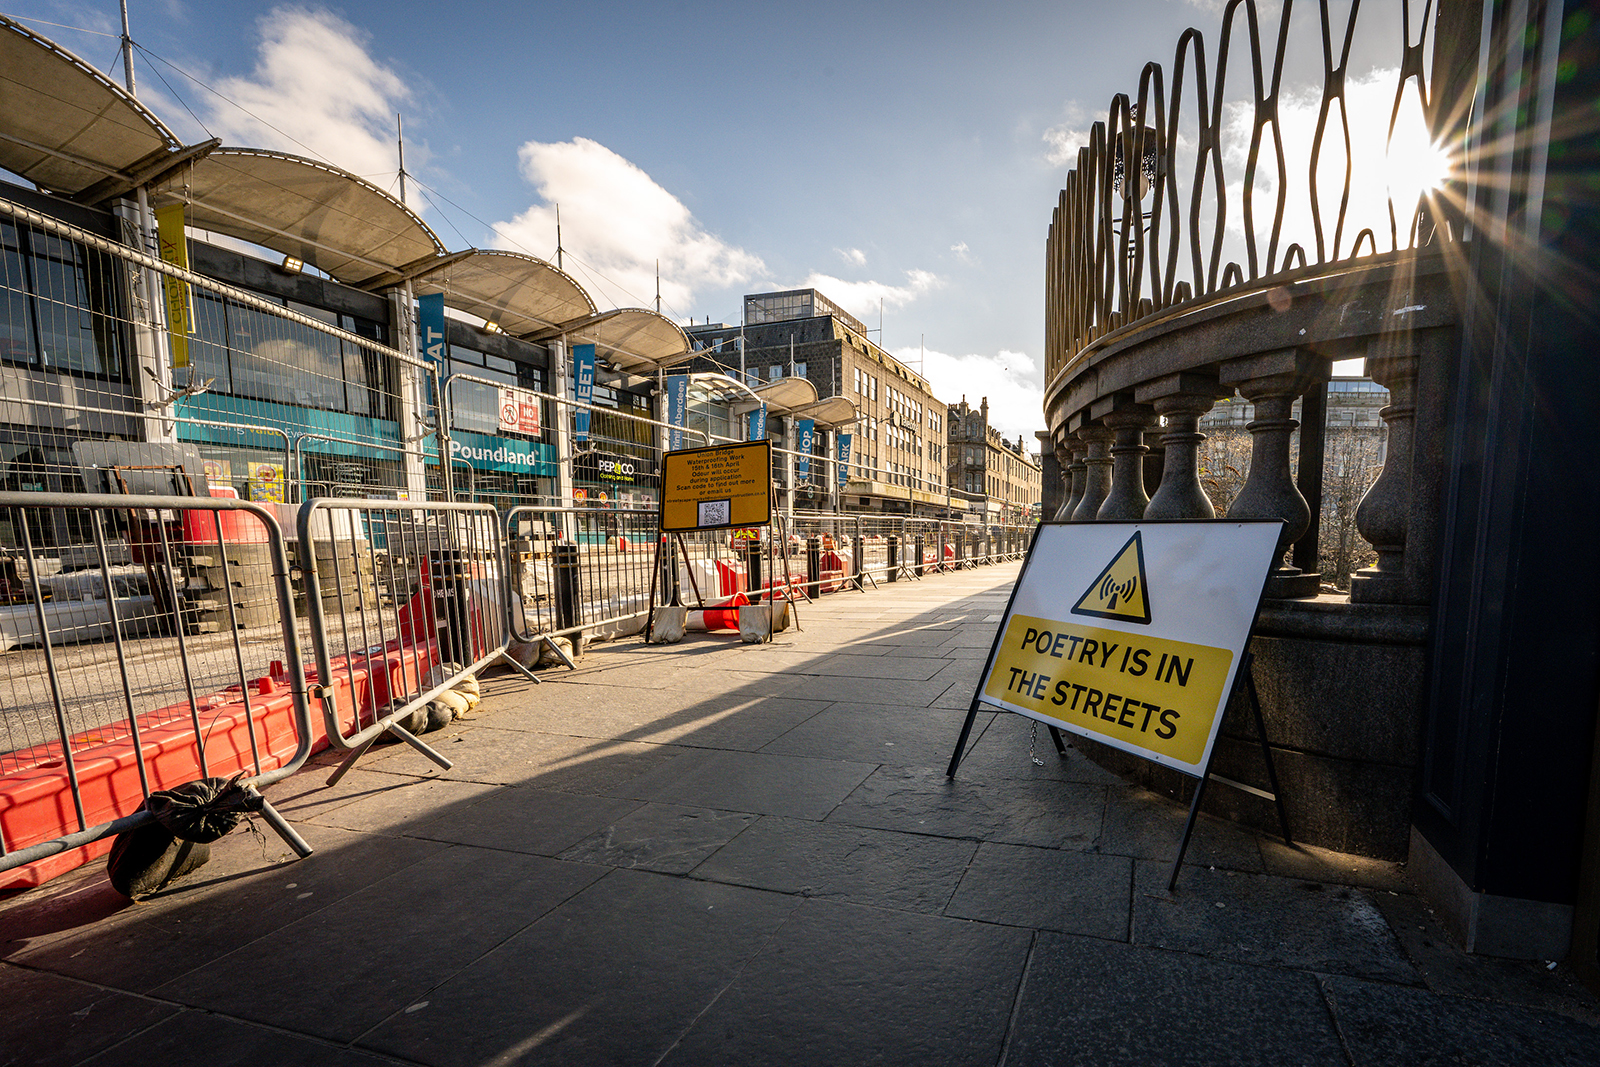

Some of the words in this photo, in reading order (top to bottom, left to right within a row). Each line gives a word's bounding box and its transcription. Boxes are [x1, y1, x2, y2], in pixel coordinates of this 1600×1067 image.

[162, 238, 182, 324] CHOPTIX
[576, 359, 593, 414] MEET
[523, 407, 534, 418] NO
[755, 408, 765, 440] berdeen
[451, 440, 536, 466] Poundland
[672, 427, 681, 451] Trinit
[800, 430, 811, 464] SHOP
[687, 456, 728, 465] Waterproofing
[696, 451, 713, 459] Union
[839, 443, 850, 473] PARK
[710, 474, 742, 482] application
[1021, 627, 1119, 668] POETRY
[1120, 646, 1152, 676] IS
[1154, 653, 1195, 687] IN
[1007, 667, 1051, 700] THE
[1051, 680, 1181, 740] STREETS
